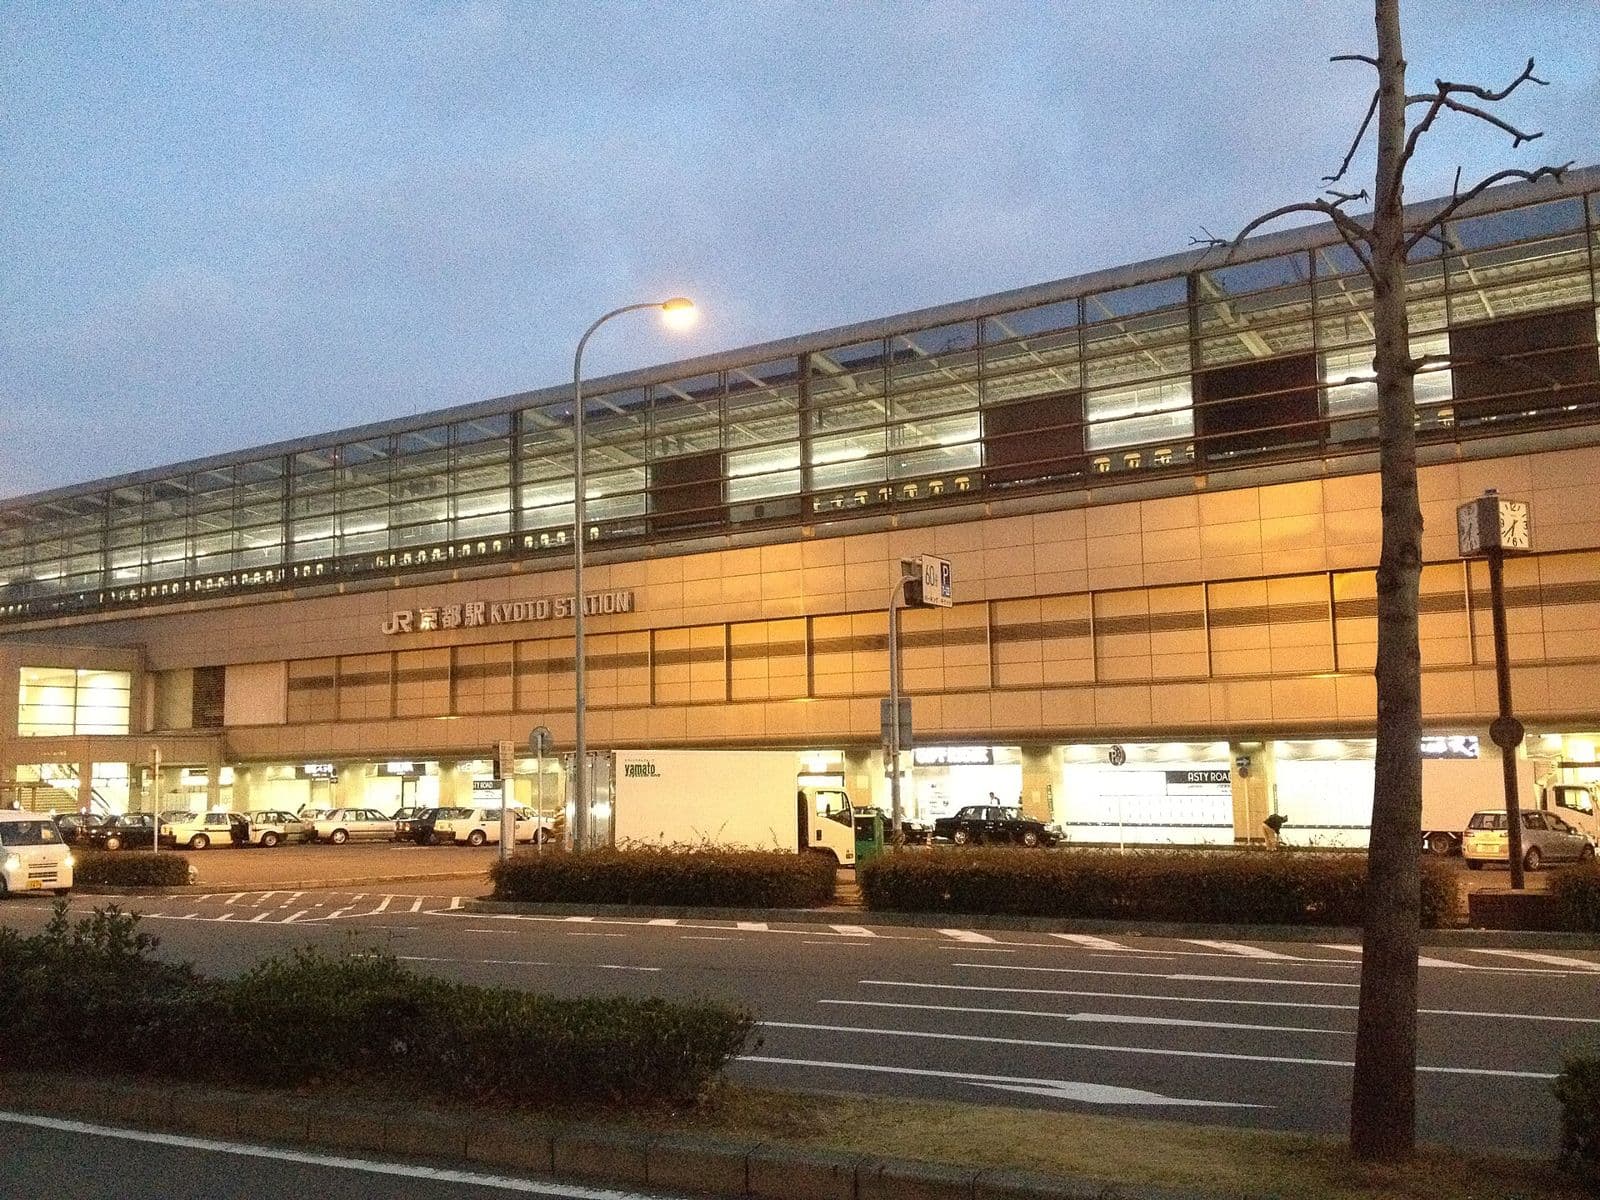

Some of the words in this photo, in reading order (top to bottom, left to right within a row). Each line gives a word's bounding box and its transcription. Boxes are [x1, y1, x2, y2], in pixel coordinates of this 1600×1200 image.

[381, 610, 414, 635] JR
[419, 601, 485, 630] 京都駅
[490, 601, 550, 624] KYOTO
[624, 761, 656, 777] yamato
[1187, 772, 1209, 782] ASTY
